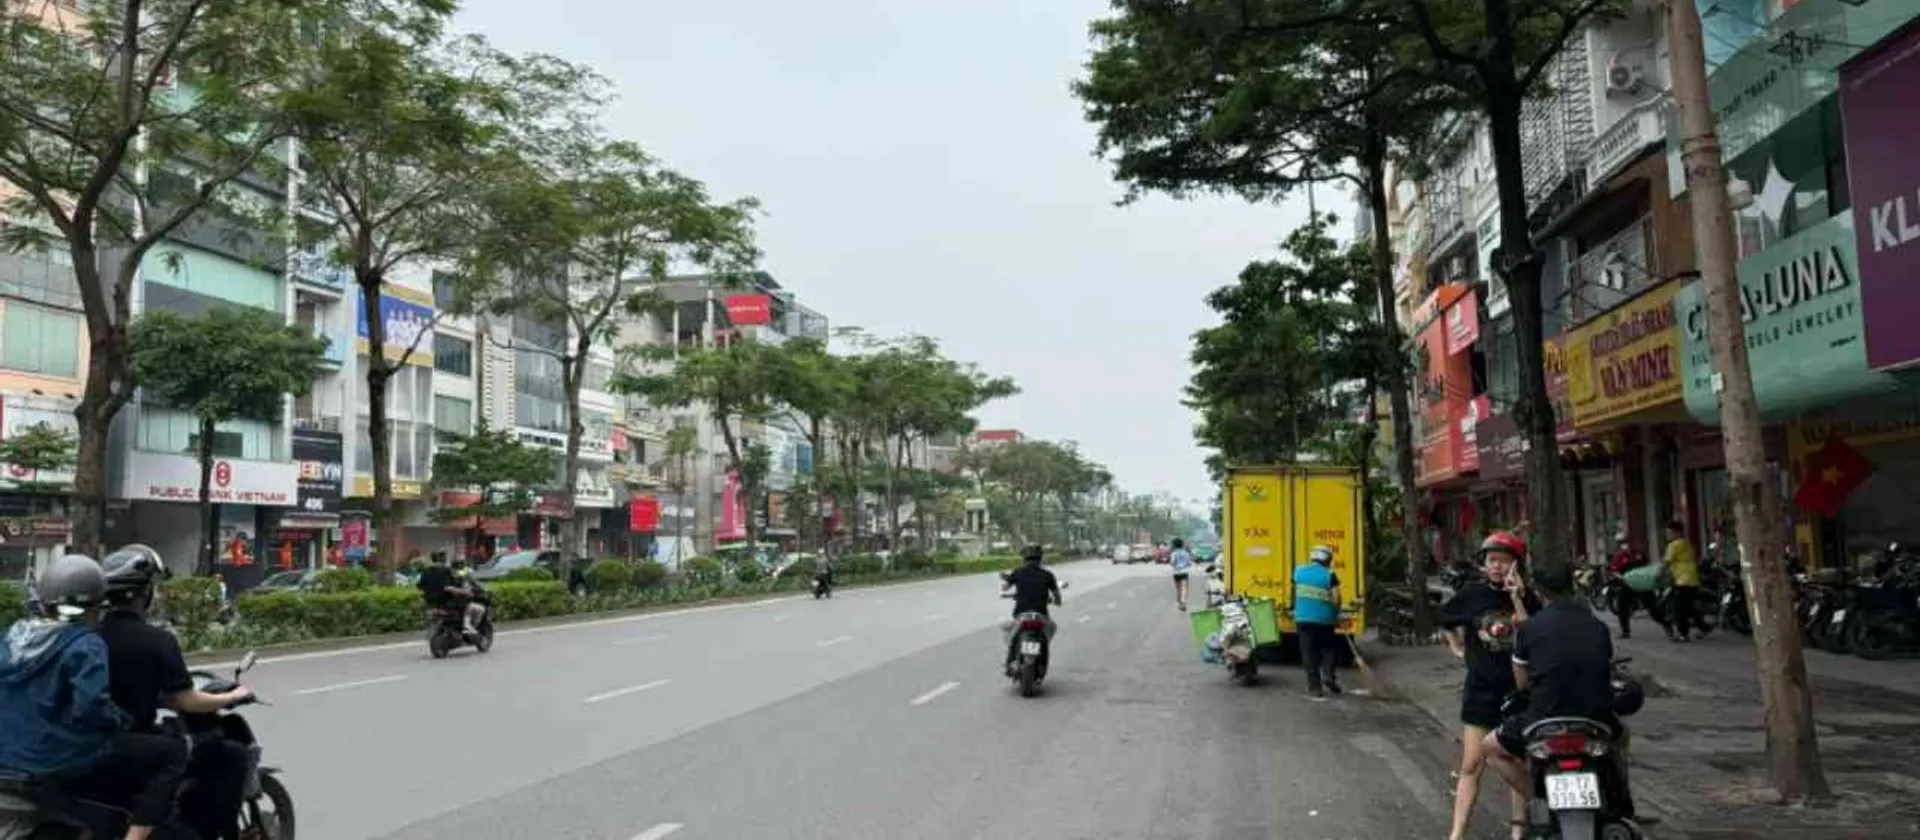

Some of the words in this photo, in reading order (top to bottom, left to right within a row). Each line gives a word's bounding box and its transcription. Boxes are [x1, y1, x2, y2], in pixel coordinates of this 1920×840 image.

[1869, 187, 1920, 253] KL
[150, 485, 194, 498] PUBLIC
[237, 490, 287, 502] VIETNAM
